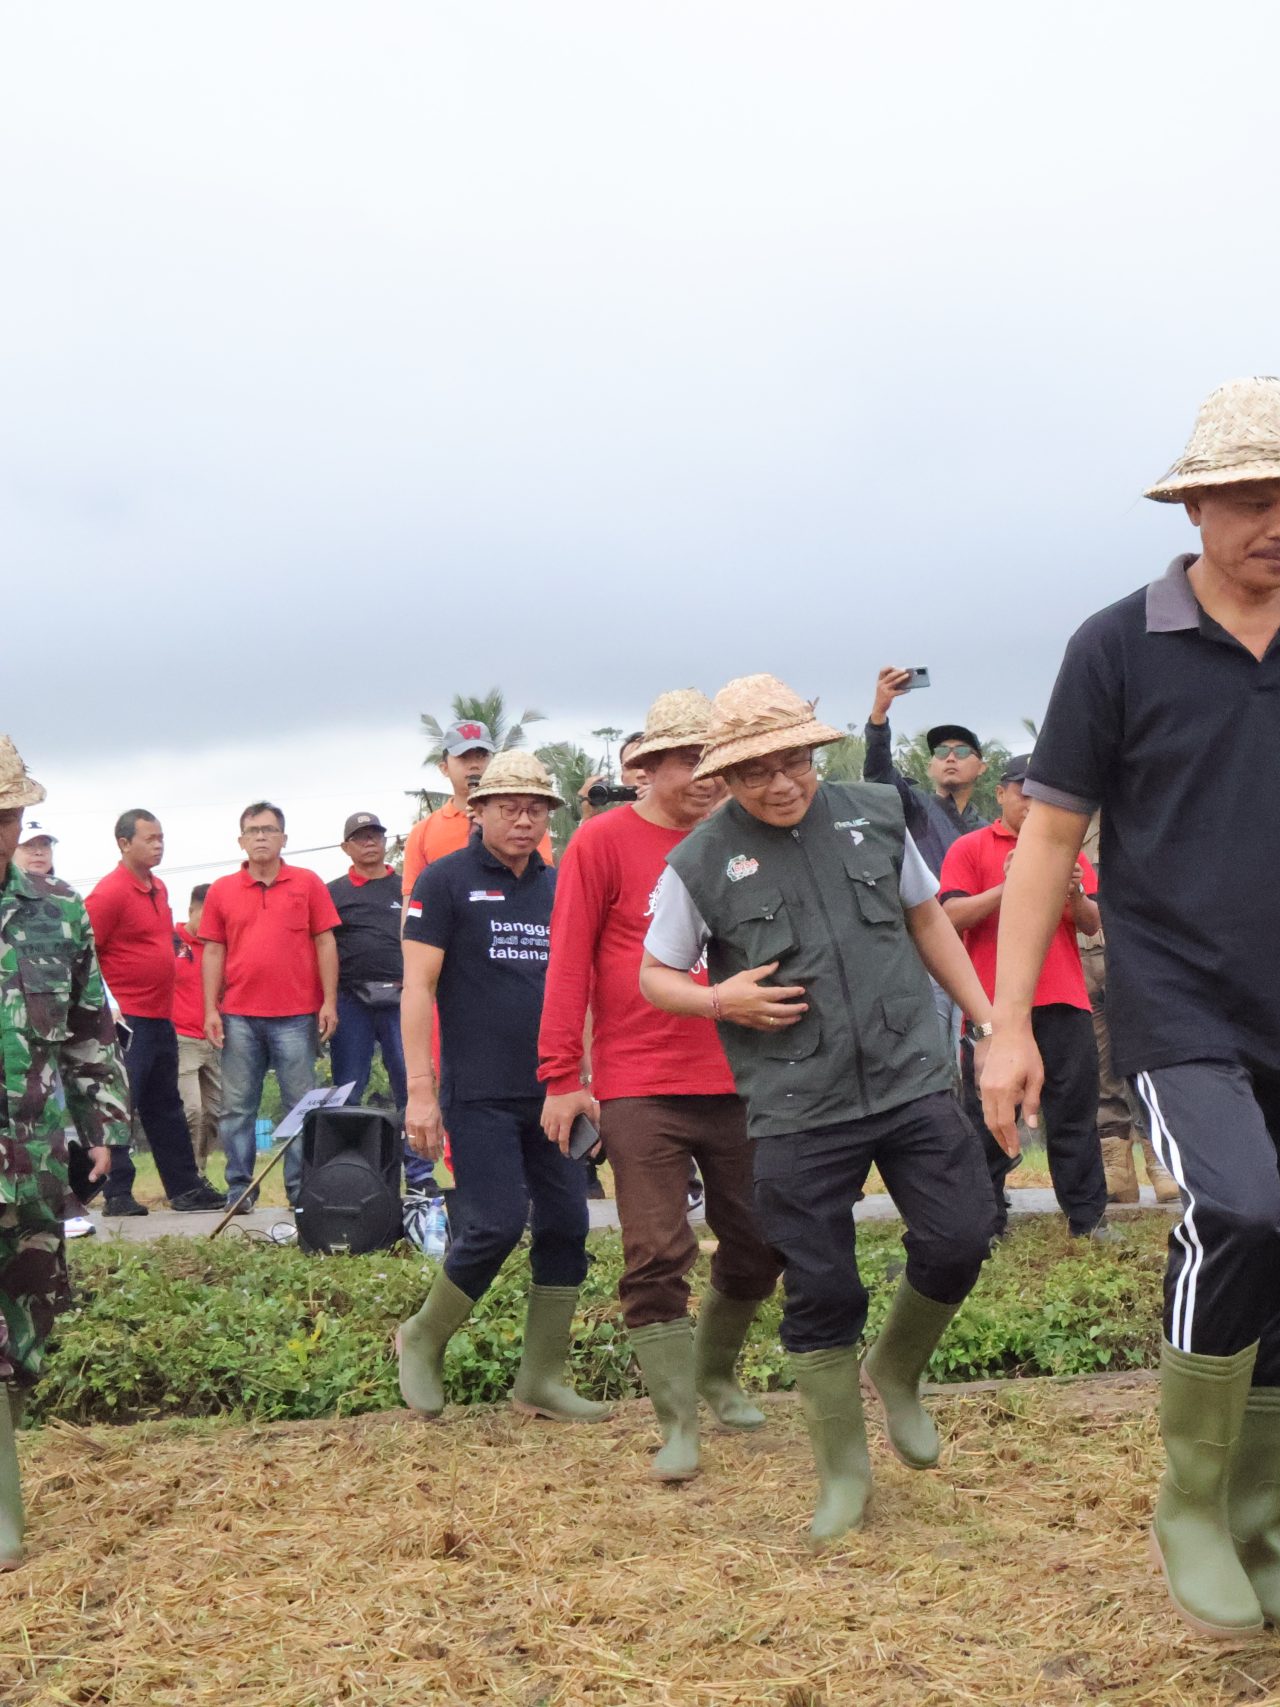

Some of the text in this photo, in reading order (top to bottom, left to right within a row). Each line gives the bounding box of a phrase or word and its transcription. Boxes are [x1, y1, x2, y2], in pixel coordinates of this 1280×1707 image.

[456, 724, 481, 740] W
[520, 937, 550, 947] oran
[488, 946, 549, 960] tabana
